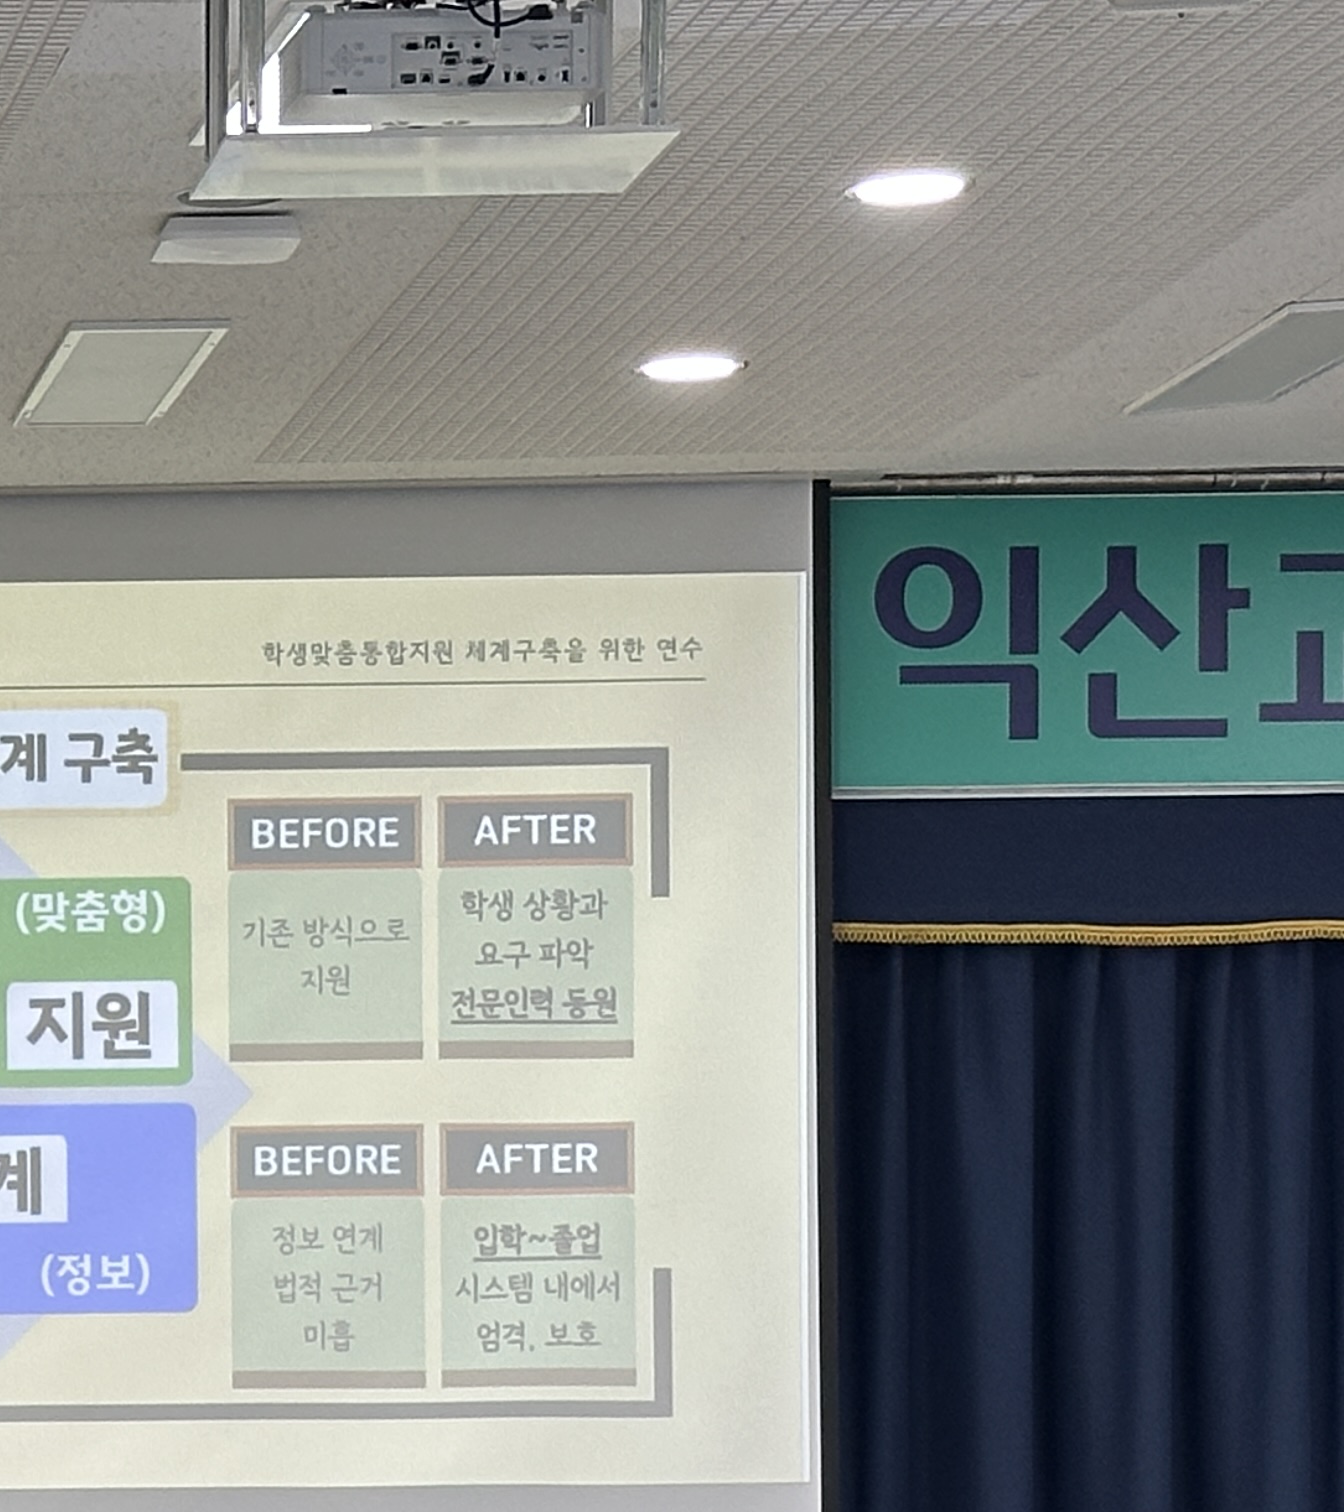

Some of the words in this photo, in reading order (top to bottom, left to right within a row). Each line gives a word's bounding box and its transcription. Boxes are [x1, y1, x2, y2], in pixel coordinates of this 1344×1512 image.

[262, 638, 454, 667] 학생맞춤통합지원
[465, 638, 587, 665] 체계구축을
[598, 637, 645, 662] 위한
[657, 635, 704, 661] 연수
[64, 728, 158, 784] 구축
[251, 818, 399, 848] BEFORE
[474, 814, 596, 845] AFTER
[16, 889, 165, 935] (맞춤형)
[461, 890, 513, 922] 학생
[523, 889, 608, 921] 상황과
[243, 918, 294, 949] 기존
[303, 916, 410, 948] 방식으로
[476, 940, 531, 969] 요구
[539, 938, 594, 969] 파악
[300, 966, 351, 996] 지원
[451, 987, 553, 1019] 전문인력
[562, 987, 618, 1019] 동원
[26, 990, 152, 1060] 지원
[254, 1145, 401, 1177] BEFORE
[475, 1143, 598, 1174] AFTER
[272, 1224, 324, 1255] 정보
[333, 1223, 384, 1254] 연계
[474, 1223, 601, 1255] 입학~졸업
[41, 1252, 150, 1296] (정보)
[274, 1273, 322, 1304] 법적
[331, 1273, 383, 1303] 근거
[456, 1272, 533, 1304] 시스템
[544, 1271, 620, 1302] 내에서
[304, 1320, 354, 1352] 미흡
[544, 1321, 602, 1347] 보호
